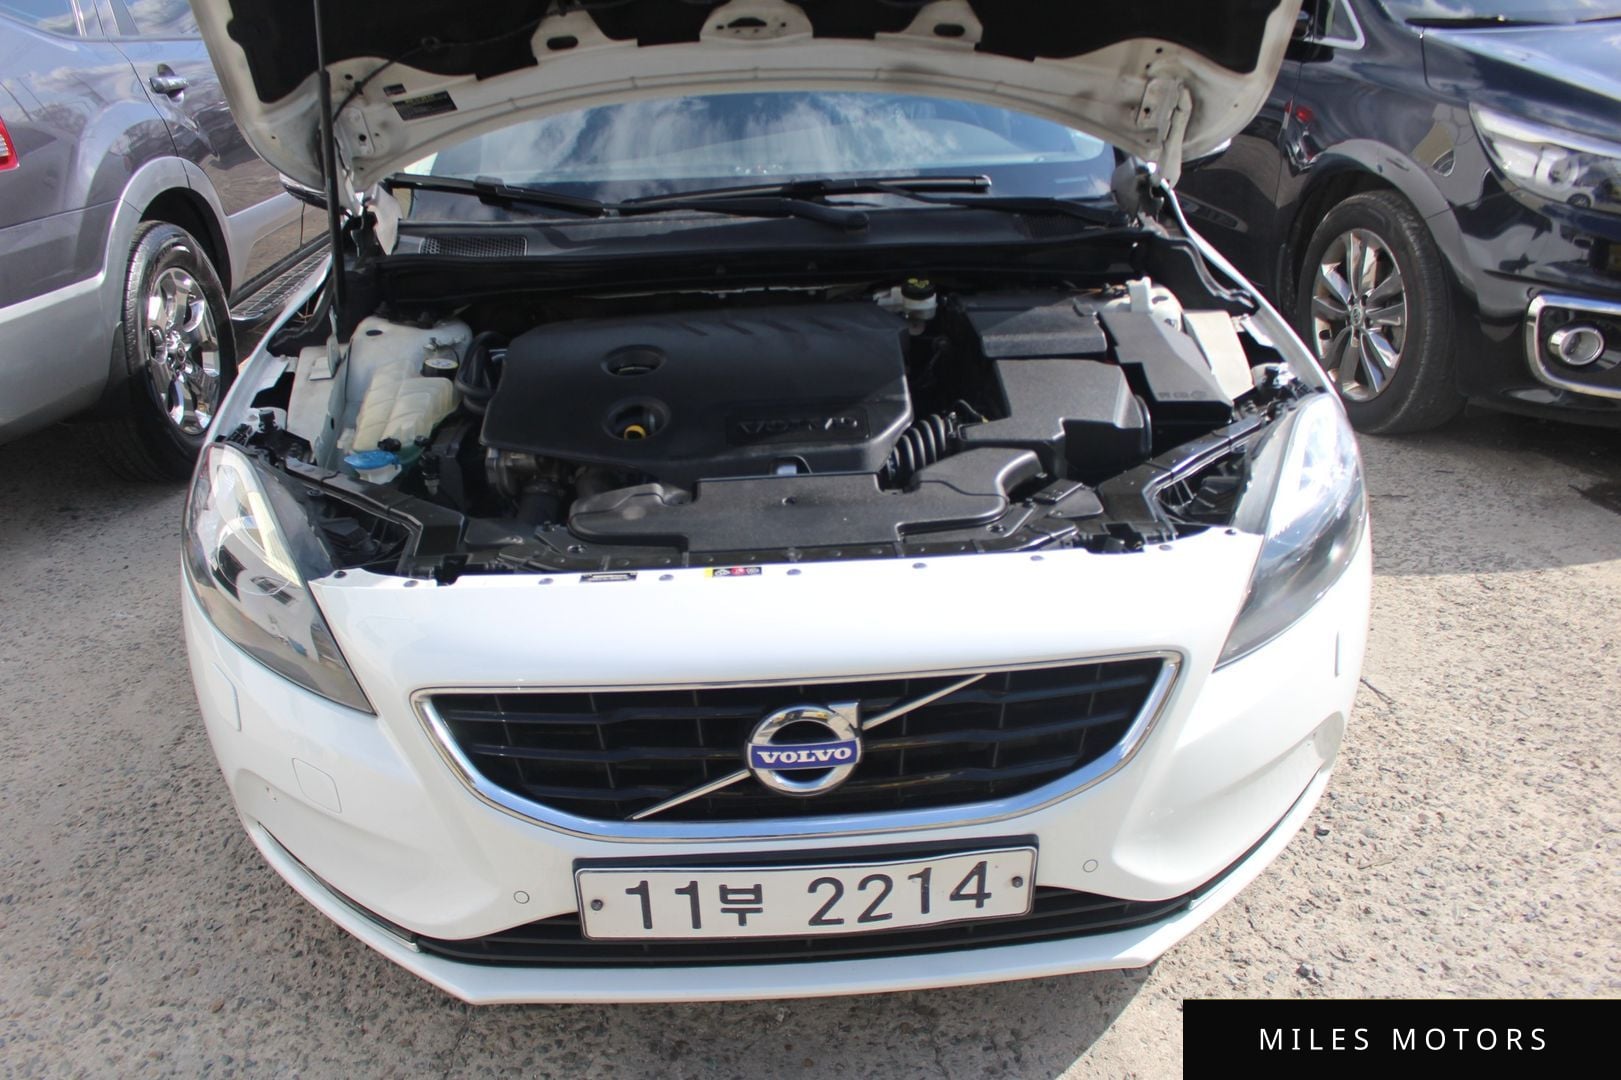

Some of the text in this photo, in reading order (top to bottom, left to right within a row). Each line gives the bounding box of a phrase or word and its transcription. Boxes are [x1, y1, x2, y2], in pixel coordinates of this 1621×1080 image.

[756, 747, 852, 764] VOLVO
[625, 860, 992, 930] 11부 2214
